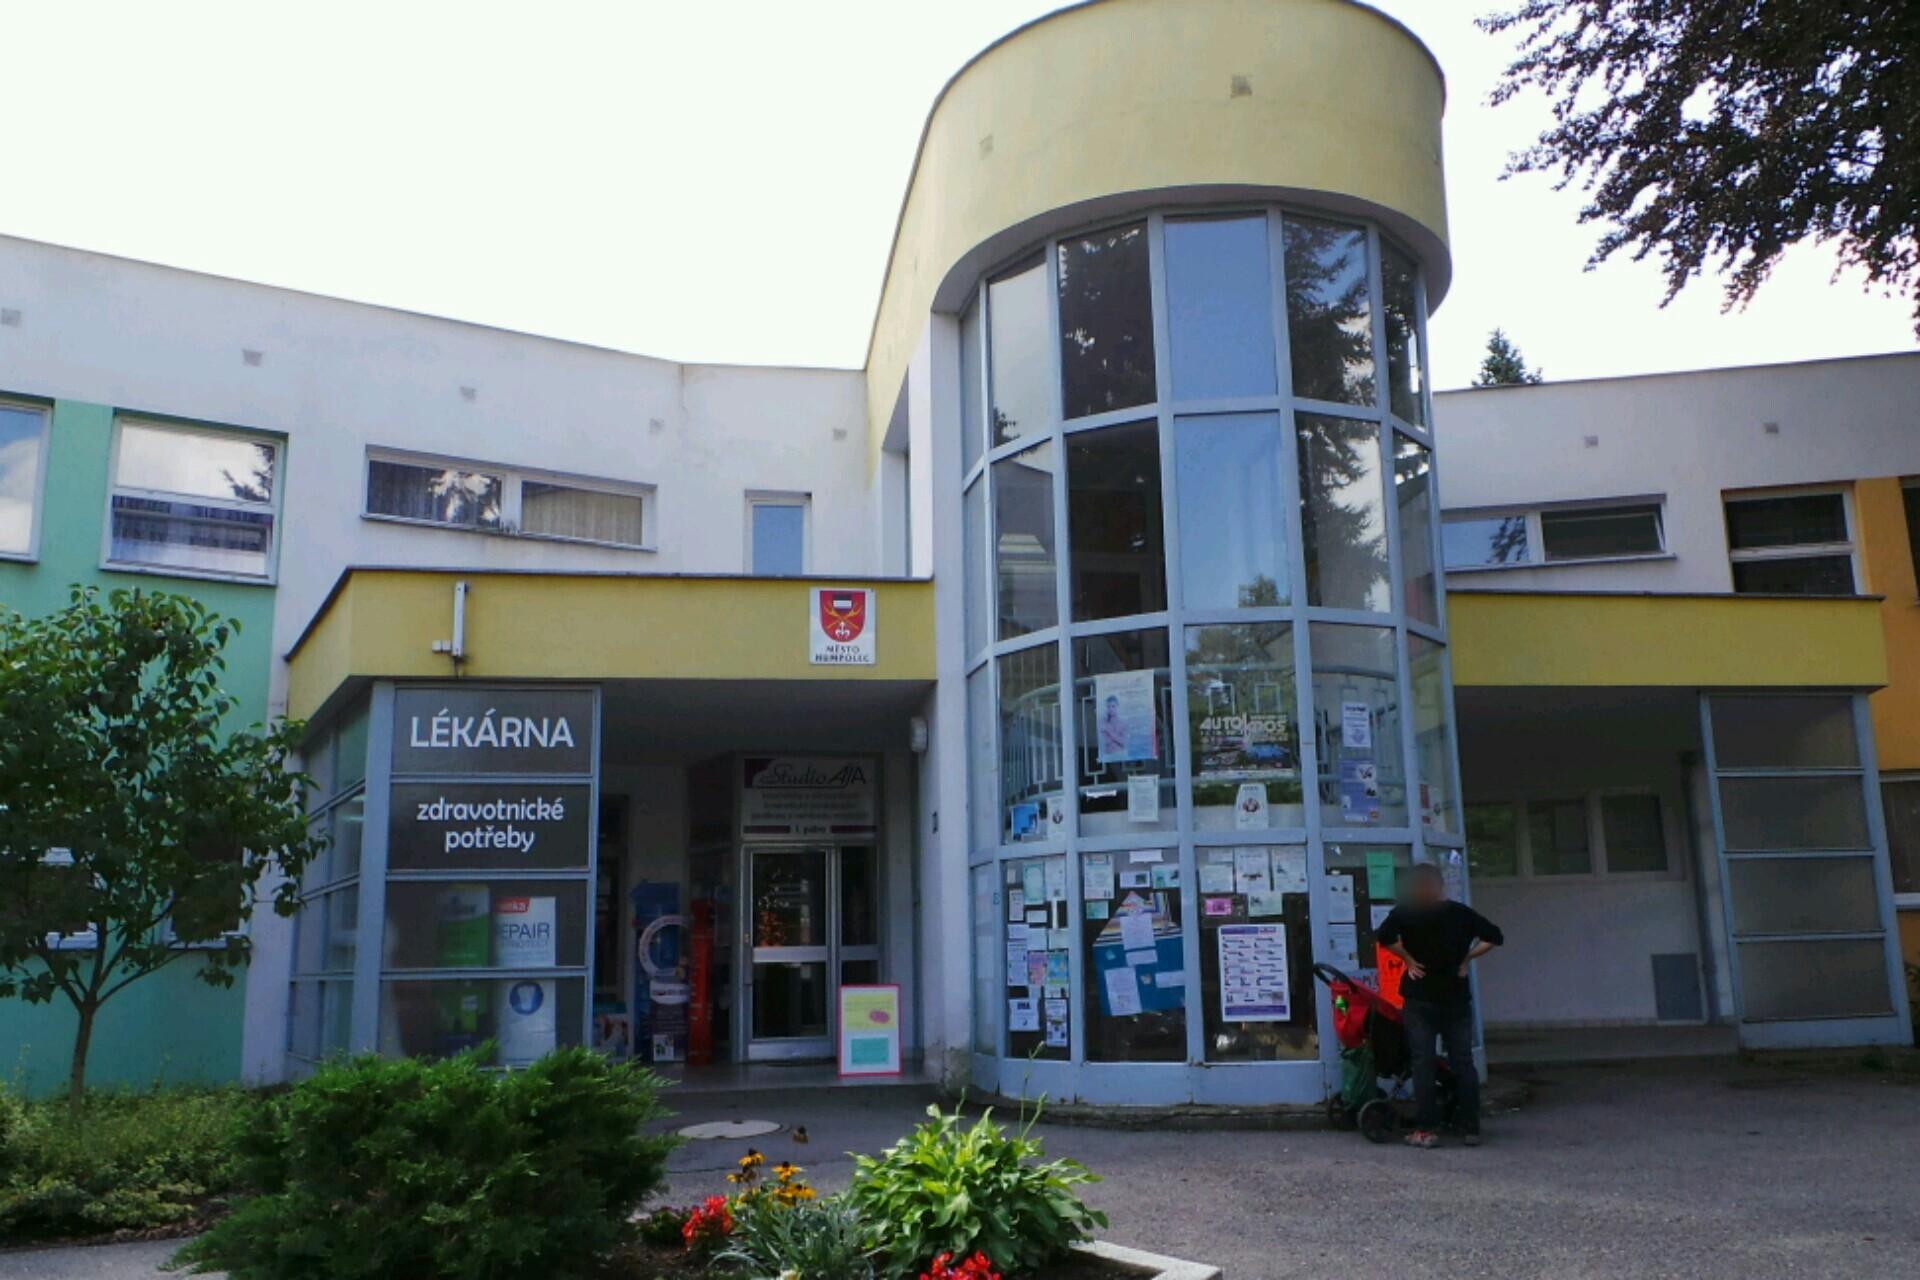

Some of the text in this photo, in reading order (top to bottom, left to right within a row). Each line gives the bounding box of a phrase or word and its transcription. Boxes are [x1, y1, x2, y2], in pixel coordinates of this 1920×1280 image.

[815, 654, 870, 663] HUMPOLEC
[410, 707, 575, 748] LÉKÁRNA
[416, 796, 565, 821] zdravotnické
[445, 824, 535, 853] potřeby
